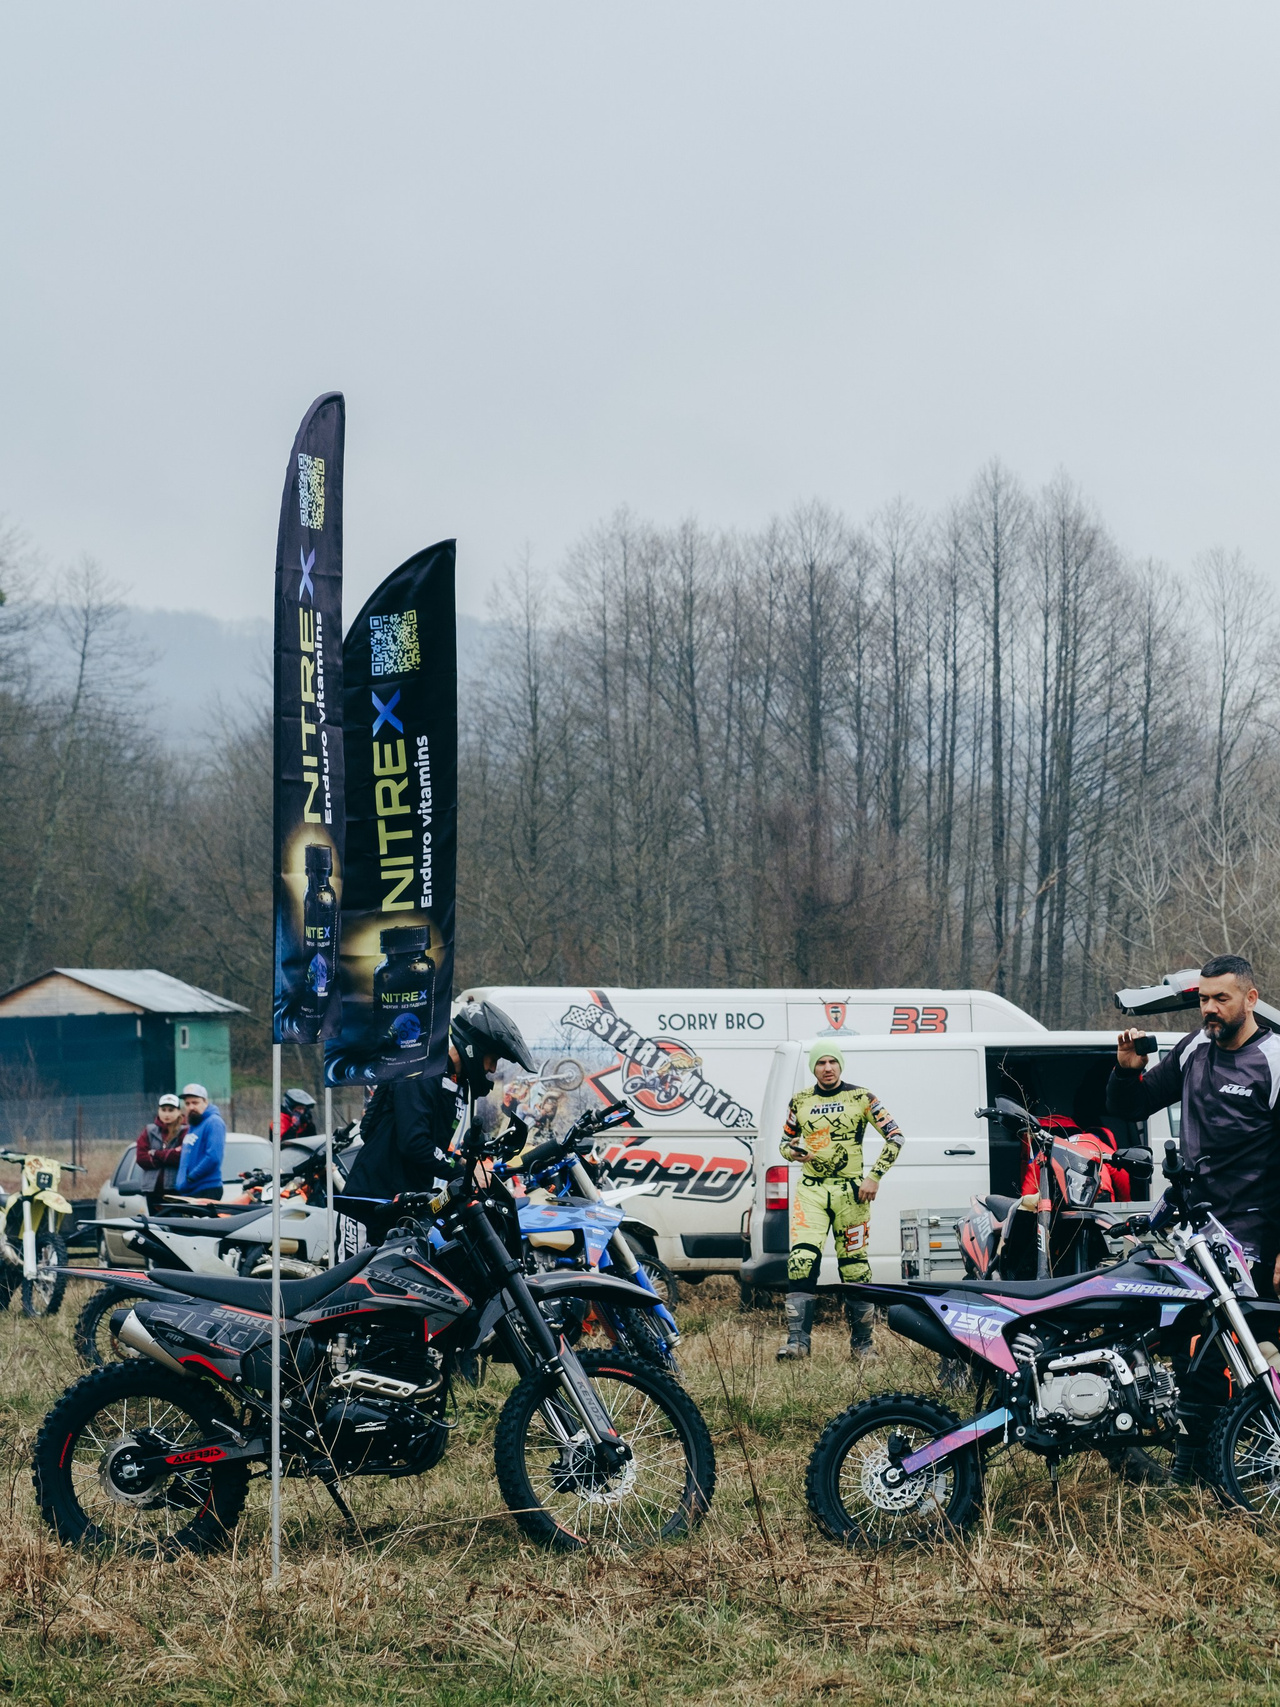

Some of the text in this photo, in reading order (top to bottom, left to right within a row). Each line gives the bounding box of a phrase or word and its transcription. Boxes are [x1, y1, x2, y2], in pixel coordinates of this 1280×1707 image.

[299, 544, 322, 824] NITREX
[314, 612, 333, 824] Enduro vitamins
[372, 689, 415, 912] NITREX
[413, 735, 433, 908] Enduro vitamins
[381, 989, 428, 1004] NITREX
[657, 1012, 765, 1031] SORRY BRO
[889, 1006, 949, 1035] 33
[594, 1012, 742, 1126] START MOTO
[1218, 1083, 1253, 1098] KTM
[809, 1105, 845, 1115] MOTO
[363, 1269, 461, 1308] SHARMAX
[1111, 1283, 1211, 1301] SHARMAX
[210, 1308, 273, 1330] SPORT
[321, 1303, 360, 1318] NIBBI
[165, 1332, 186, 1344] AIR
[966, 1329, 996, 1341] SPORT
[576, 1381, 601, 1422] KENDA
[173, 1448, 222, 1463] ACERBIS
